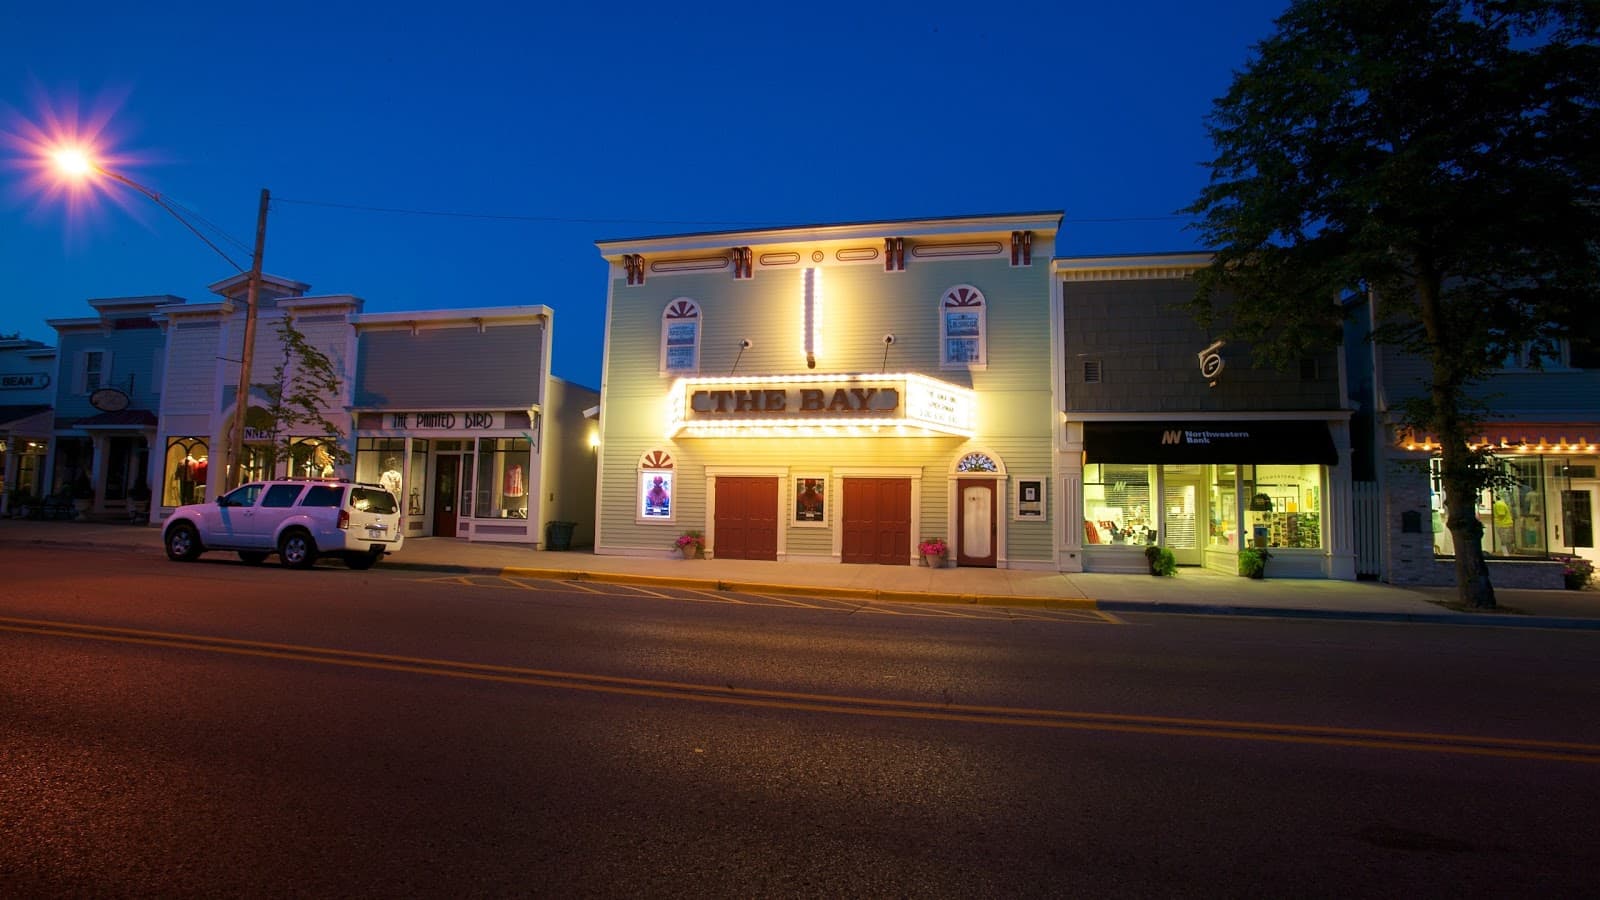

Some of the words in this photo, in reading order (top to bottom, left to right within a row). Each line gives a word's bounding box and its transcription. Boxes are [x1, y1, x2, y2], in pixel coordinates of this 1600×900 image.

[3, 376, 34, 386] BEAN
[710, 389, 787, 413] THE
[799, 388, 878, 412] BAY
[393, 412, 408, 430] THE
[465, 412, 493, 429] BIRD
